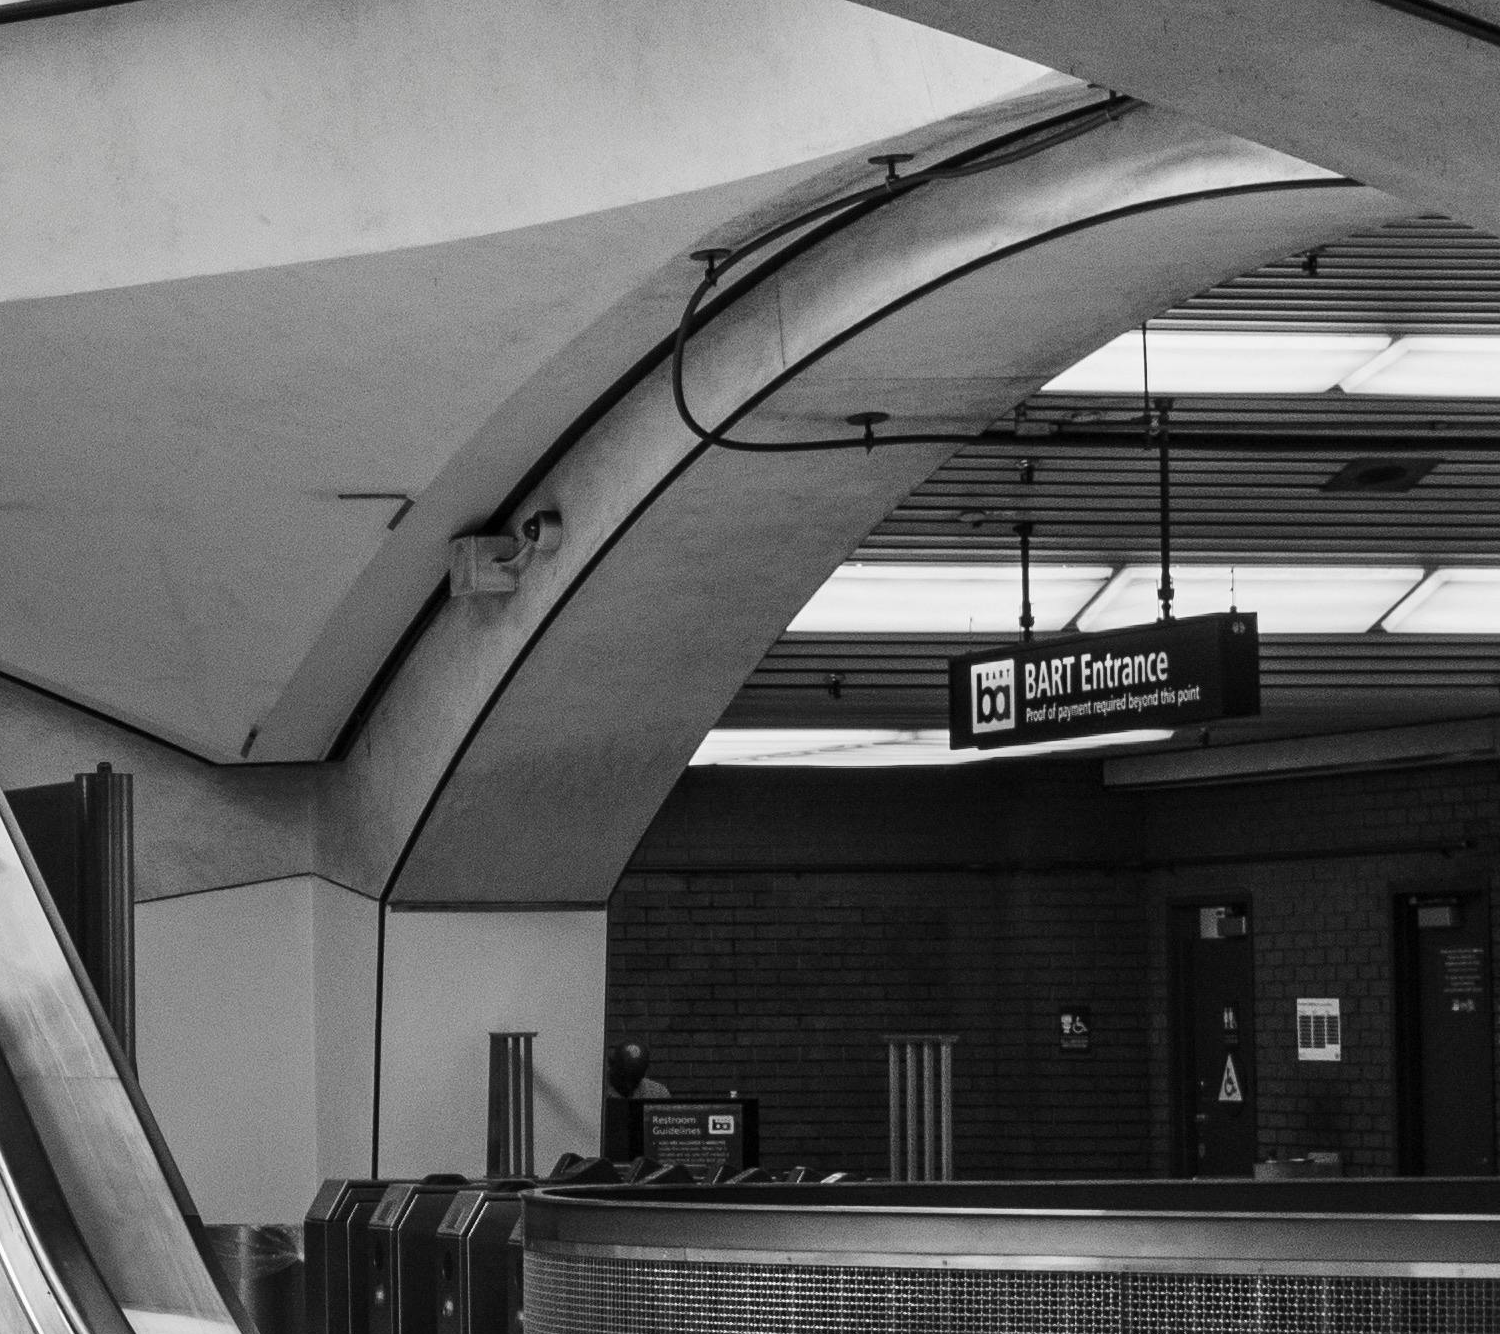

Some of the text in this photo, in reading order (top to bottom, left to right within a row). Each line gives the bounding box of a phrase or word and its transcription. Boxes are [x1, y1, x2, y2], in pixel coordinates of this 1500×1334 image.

[1025, 651, 1169, 700] BART Entrance
[1026, 684, 1200, 723] Proof of payment required beyond this point
[652, 1115, 697, 1125] Restroom
[652, 1126, 701, 1136] Guidelines
